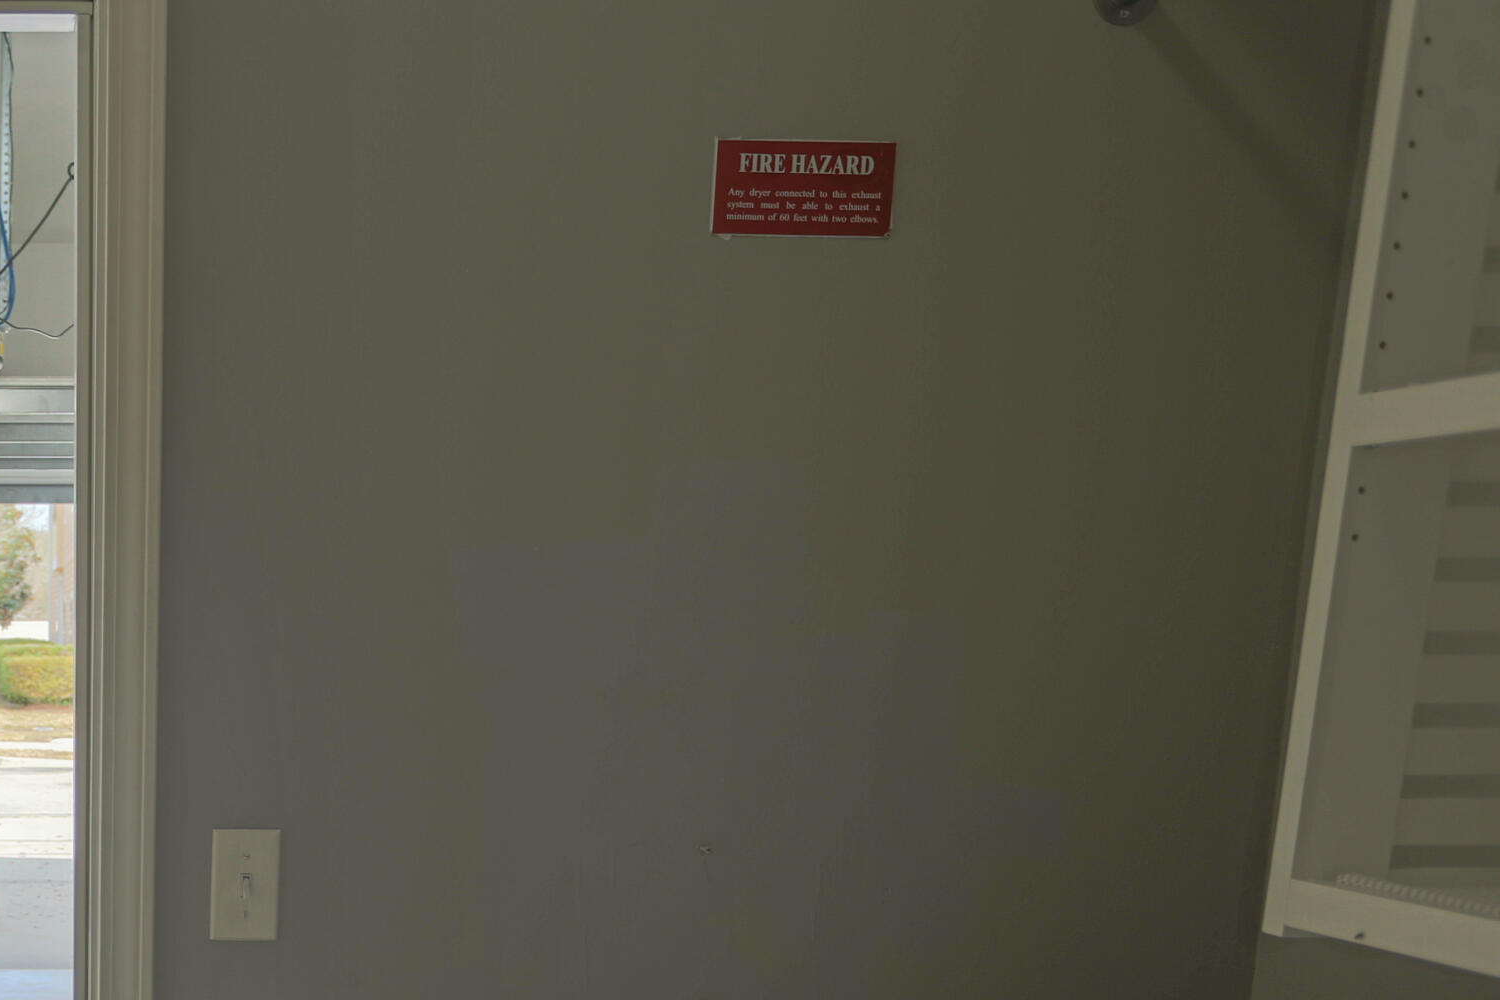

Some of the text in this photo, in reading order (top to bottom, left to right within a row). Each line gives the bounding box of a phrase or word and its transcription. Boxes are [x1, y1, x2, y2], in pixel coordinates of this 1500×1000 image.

[738, 152, 875, 176] FIRE HAZARD
[728, 188, 744, 198] Any
[749, 188, 772, 198] dryer
[775, 189, 815, 198] connected
[832, 190, 847, 199] this
[851, 191, 882, 200] exhaust
[727, 201, 754, 210] system
[760, 201, 780, 209] must
[786, 201, 796, 210] be
[802, 201, 818, 210] able
[825, 202, 833, 210] to
[839, 202, 870, 211] exhaust
[726, 213, 880, 224] minimum of 60 feet with two elbows.
